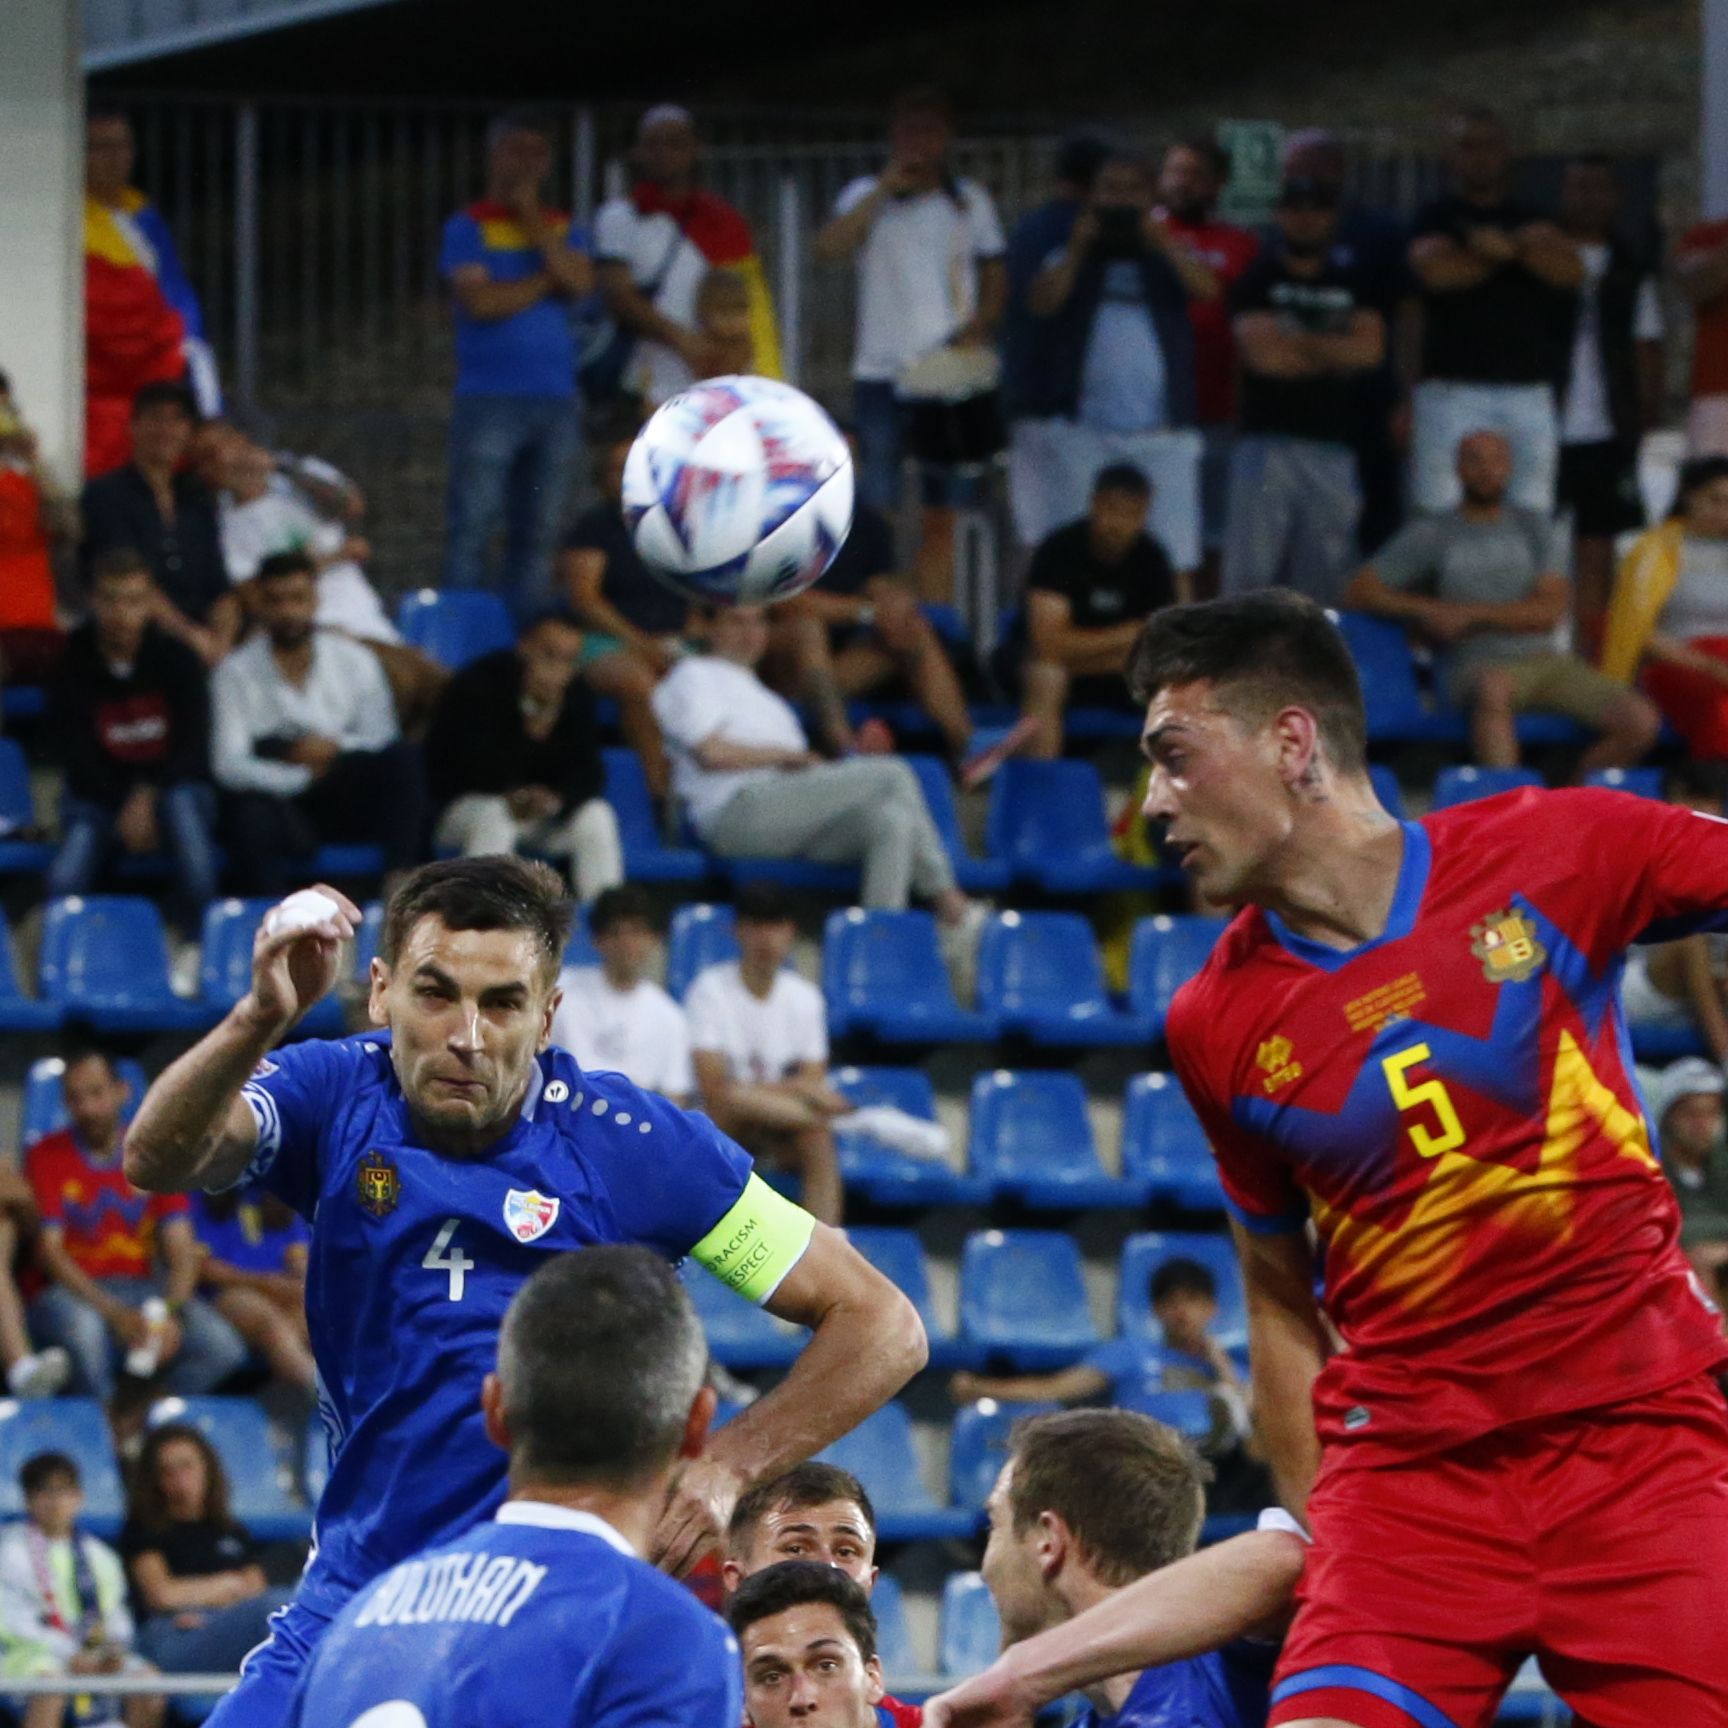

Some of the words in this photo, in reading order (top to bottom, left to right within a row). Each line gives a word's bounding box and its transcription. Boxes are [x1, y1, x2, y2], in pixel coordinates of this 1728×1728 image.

[1381, 1042, 1466, 1158] 5
[422, 1218, 474, 1301] 4
[728, 1242, 770, 1287] ESPECT
